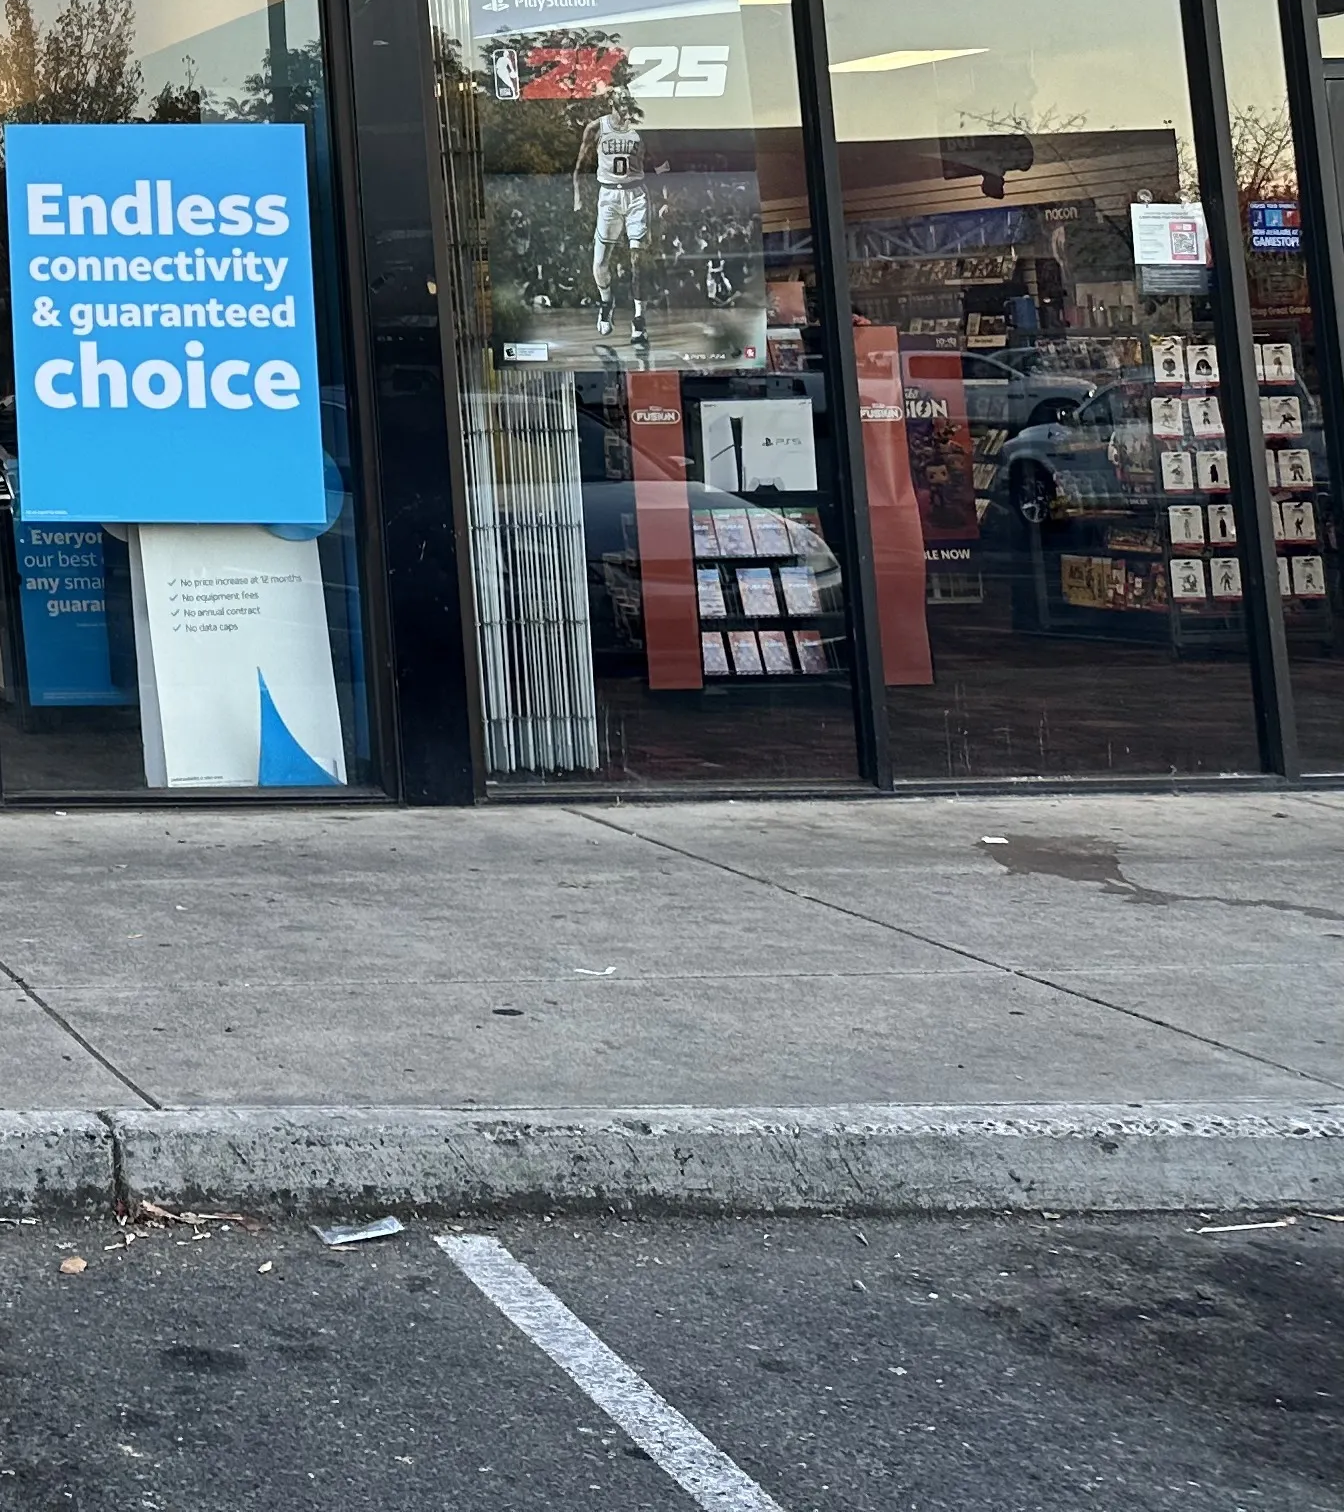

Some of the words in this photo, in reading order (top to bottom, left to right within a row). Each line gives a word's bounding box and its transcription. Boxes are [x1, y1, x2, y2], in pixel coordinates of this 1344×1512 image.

[613, 157, 628, 176] 0
[26, 179, 290, 236] Endless
[1045, 206, 1078, 221] nacon
[28, 246, 290, 292] connectivity
[31, 295, 63, 328] &
[69, 295, 297, 336] guaranteed
[33, 339, 302, 411] choice
[24, 554, 55, 568] our
[57, 550, 98, 568] best
[940, 549, 971, 560] NOW
[25, 576, 60, 594] any
[180, 579, 192, 587] No
[194, 578, 214, 589] price
[215, 576, 249, 586] increase
[250, 576, 259, 585] at
[260, 575, 269, 584] 12
[270, 574, 303, 584] months
[181, 593, 194, 602] No
[196, 592, 240, 603] equipment
[241, 590, 259, 600] fees
[183, 608, 196, 617] No
[197, 607, 225, 616] annual
[226, 606, 261, 616] contract
[185, 624, 197, 633] No
[199, 623, 218, 632] data
[219, 623, 239, 632] caps
